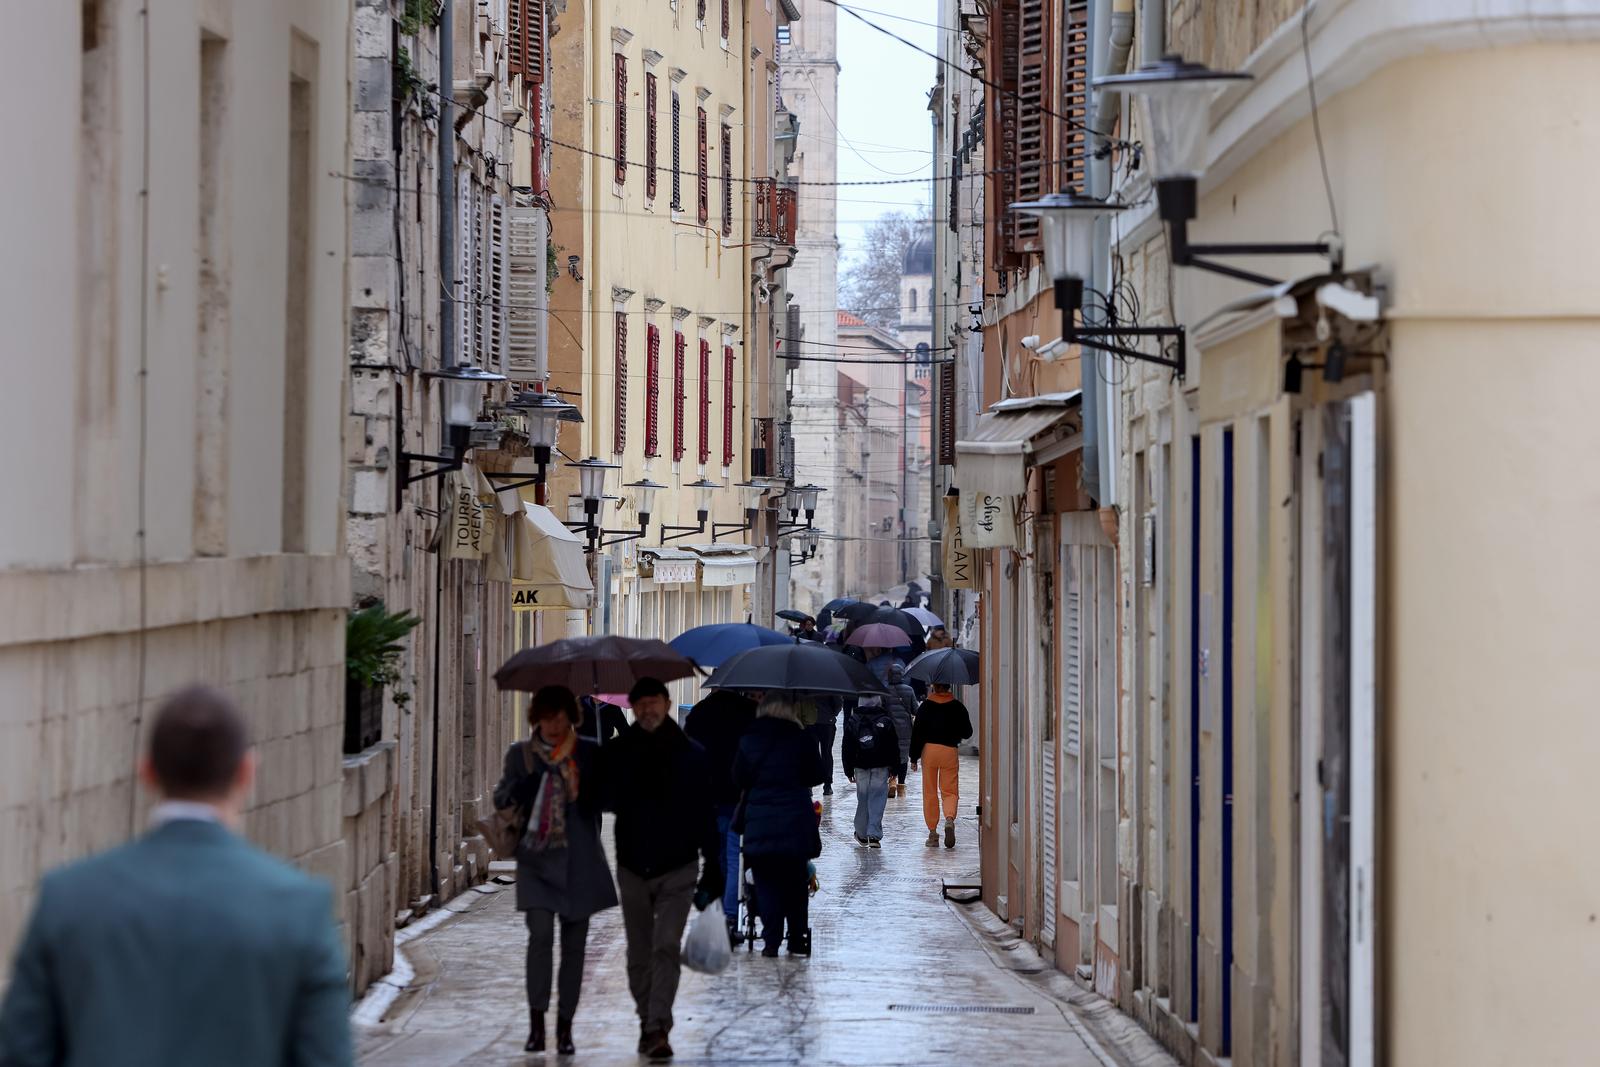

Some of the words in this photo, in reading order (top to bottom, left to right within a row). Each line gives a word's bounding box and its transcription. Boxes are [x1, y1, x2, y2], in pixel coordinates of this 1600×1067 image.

[456, 483, 471, 549] TOURIST
[470, 494, 481, 552] AGENC
[978, 495, 1001, 534] Shop
[512, 590, 539, 604] AK
